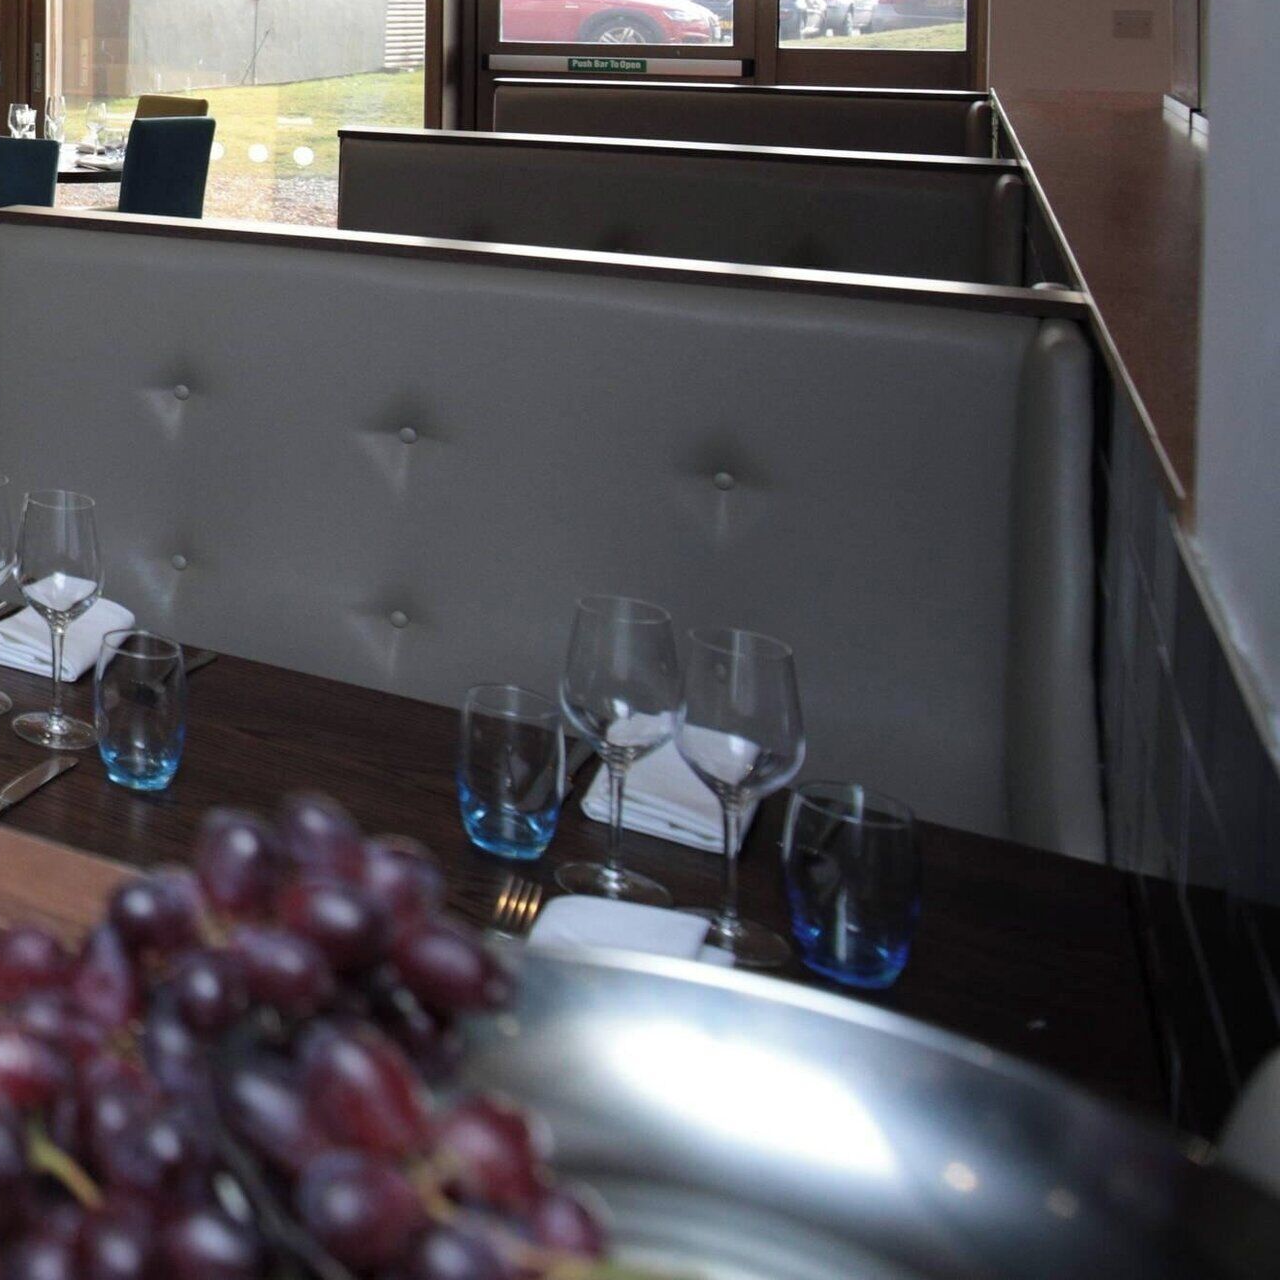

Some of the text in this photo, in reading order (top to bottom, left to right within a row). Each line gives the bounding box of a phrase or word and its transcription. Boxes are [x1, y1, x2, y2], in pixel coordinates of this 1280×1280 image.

[572, 59, 641, 69] Push Bar To Open
